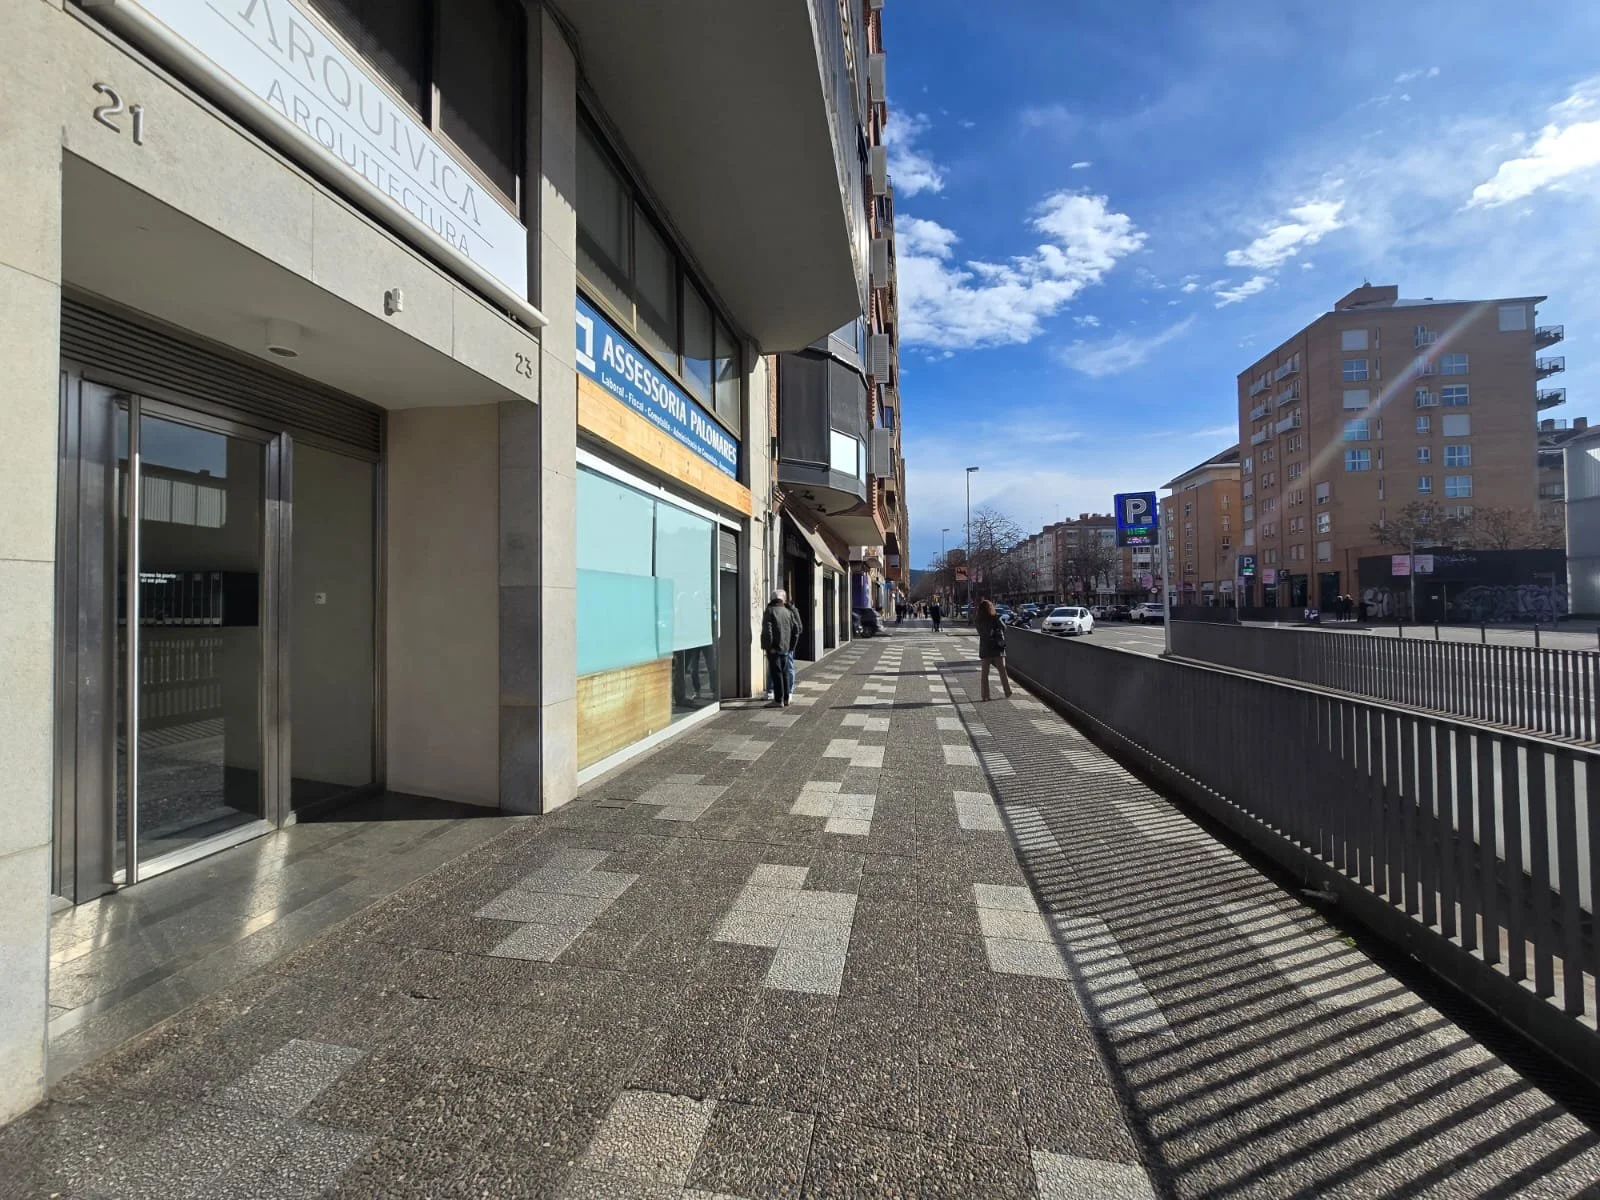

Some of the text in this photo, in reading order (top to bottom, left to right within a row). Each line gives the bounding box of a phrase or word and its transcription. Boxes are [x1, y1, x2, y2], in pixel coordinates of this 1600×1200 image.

[92, 82, 144, 146] 21
[266, 79, 470, 257] ARQUITECTURA
[515, 352, 532, 379] 23
[601, 372, 625, 398] Laboral
[628, 392, 644, 412] Fiscal
[602, 334, 737, 465] ASSESSORIA PALOMARES
[1126, 498, 1147, 523] P
[1244, 557, 1253, 567] P
